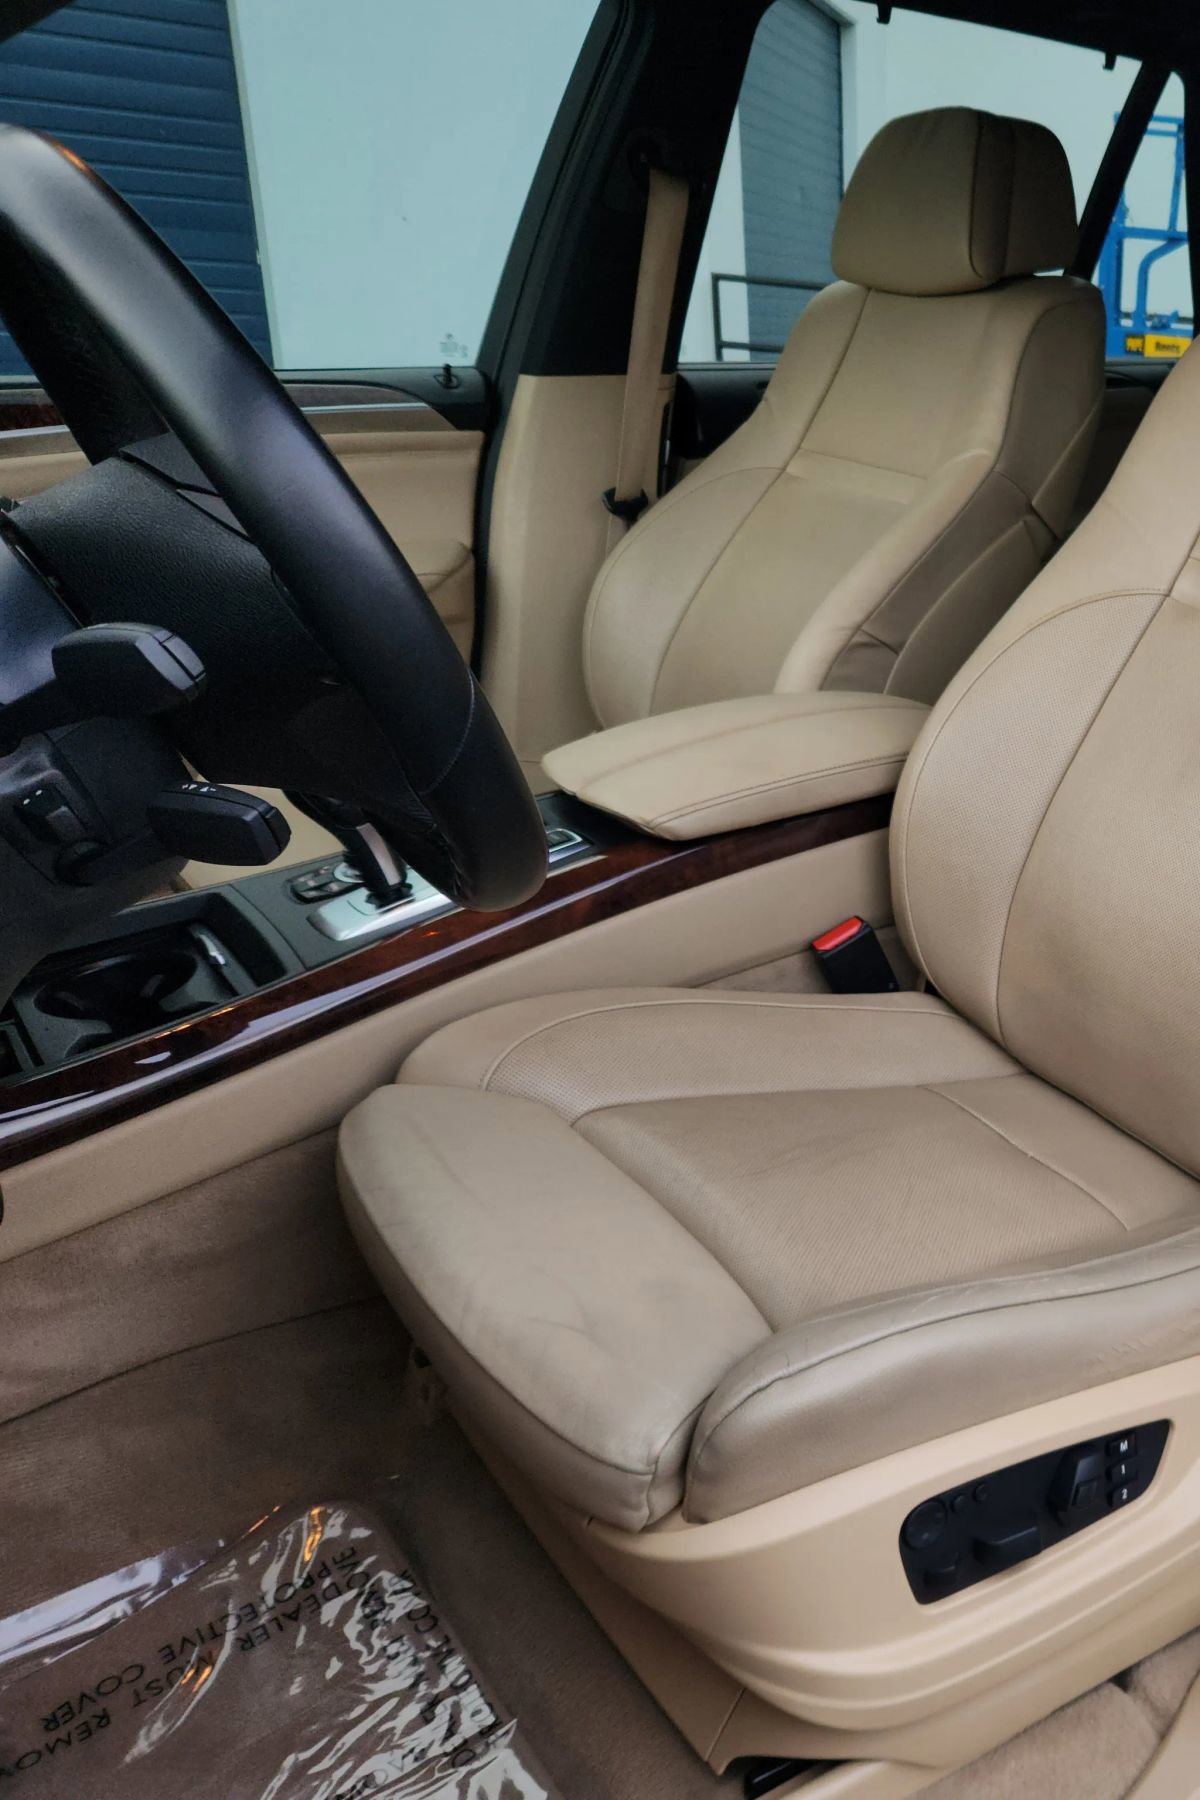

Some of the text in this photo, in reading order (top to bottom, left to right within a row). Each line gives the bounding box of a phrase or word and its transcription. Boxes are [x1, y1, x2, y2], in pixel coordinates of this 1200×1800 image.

[1120, 1440, 1128, 1452] M
[1122, 1488, 1128, 1500] 2
[235, 1582, 342, 1651] DEALER
[40, 1561, 331, 1732] PROTECTIVE COVER
